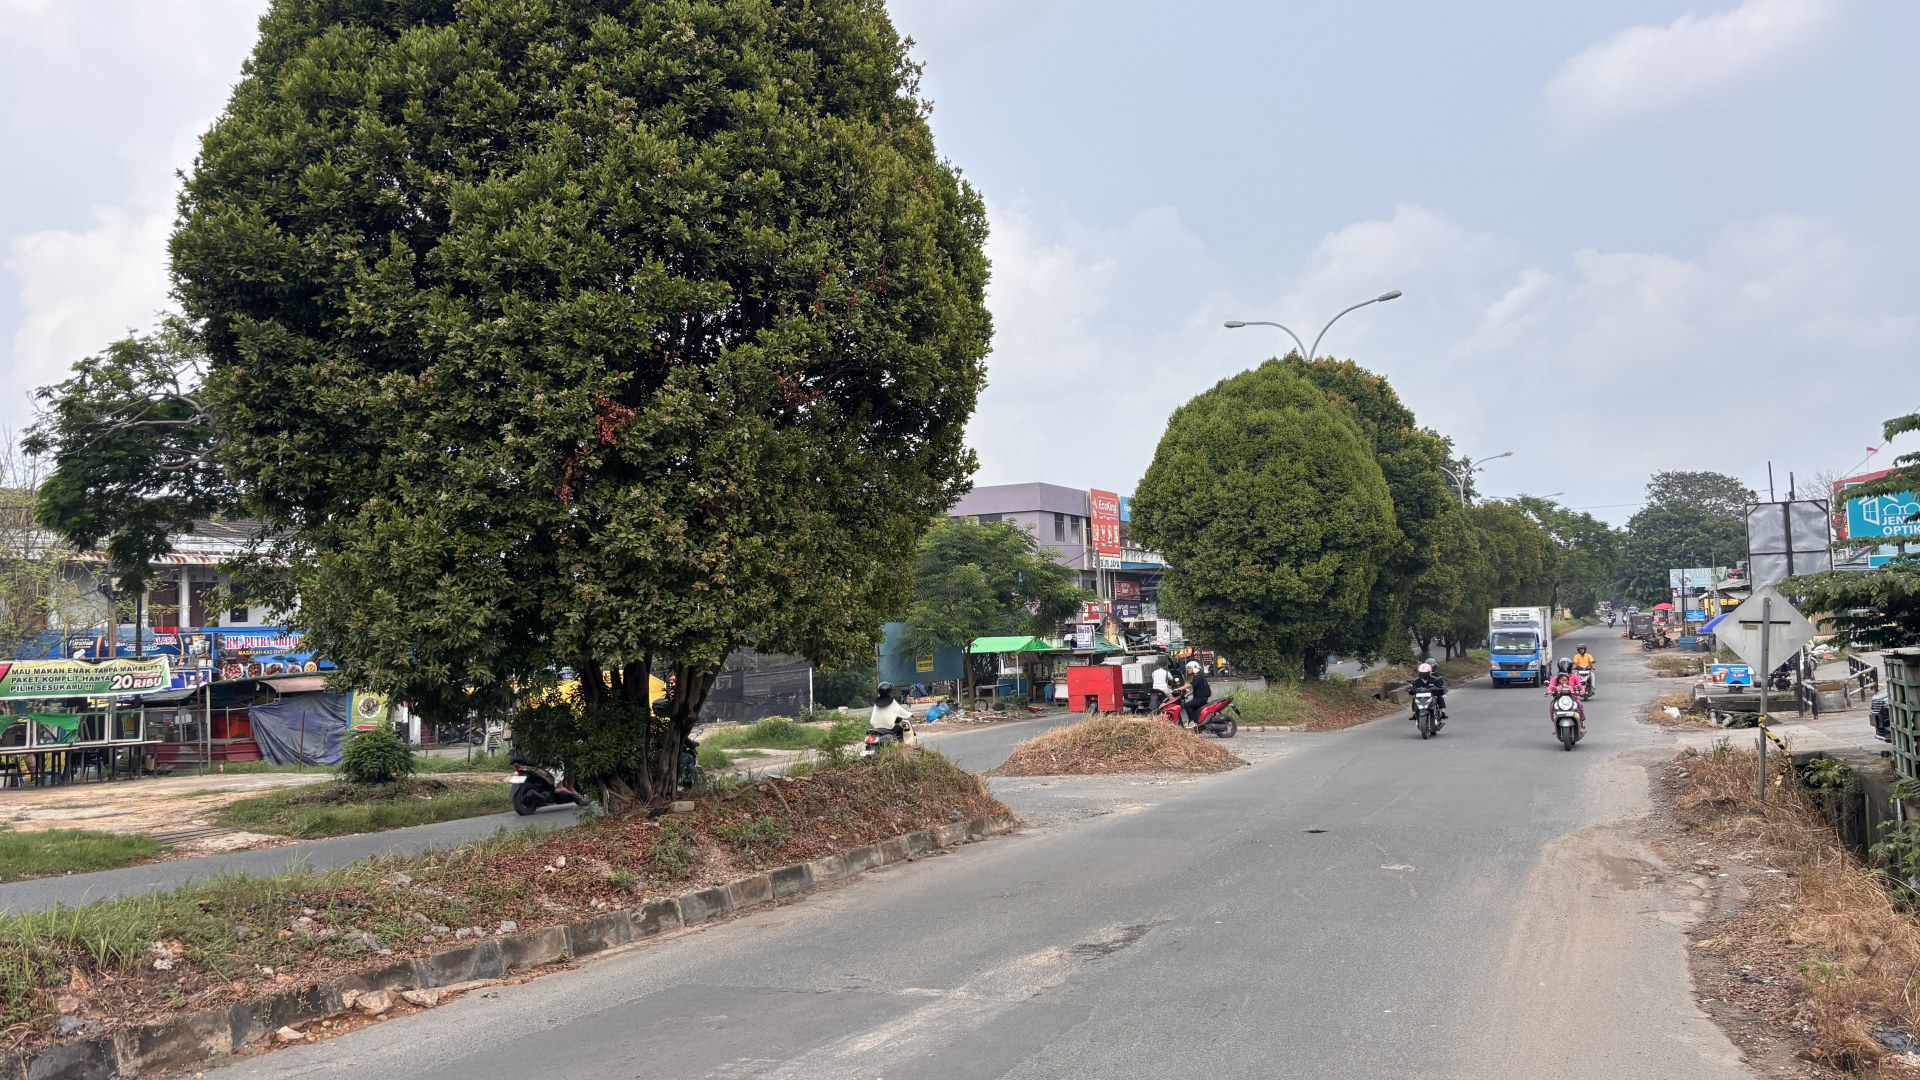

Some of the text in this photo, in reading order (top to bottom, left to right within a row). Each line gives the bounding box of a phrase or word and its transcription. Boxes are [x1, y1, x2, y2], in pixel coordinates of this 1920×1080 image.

[244, 635, 271, 648] PUTRA
[11, 676, 39, 684] PAKET
[42, 675, 79, 683] KOMPLIT
[82, 675, 110, 683] HANYA
[110, 673, 133, 690] 20
[133, 676, 163, 689] RIBU
